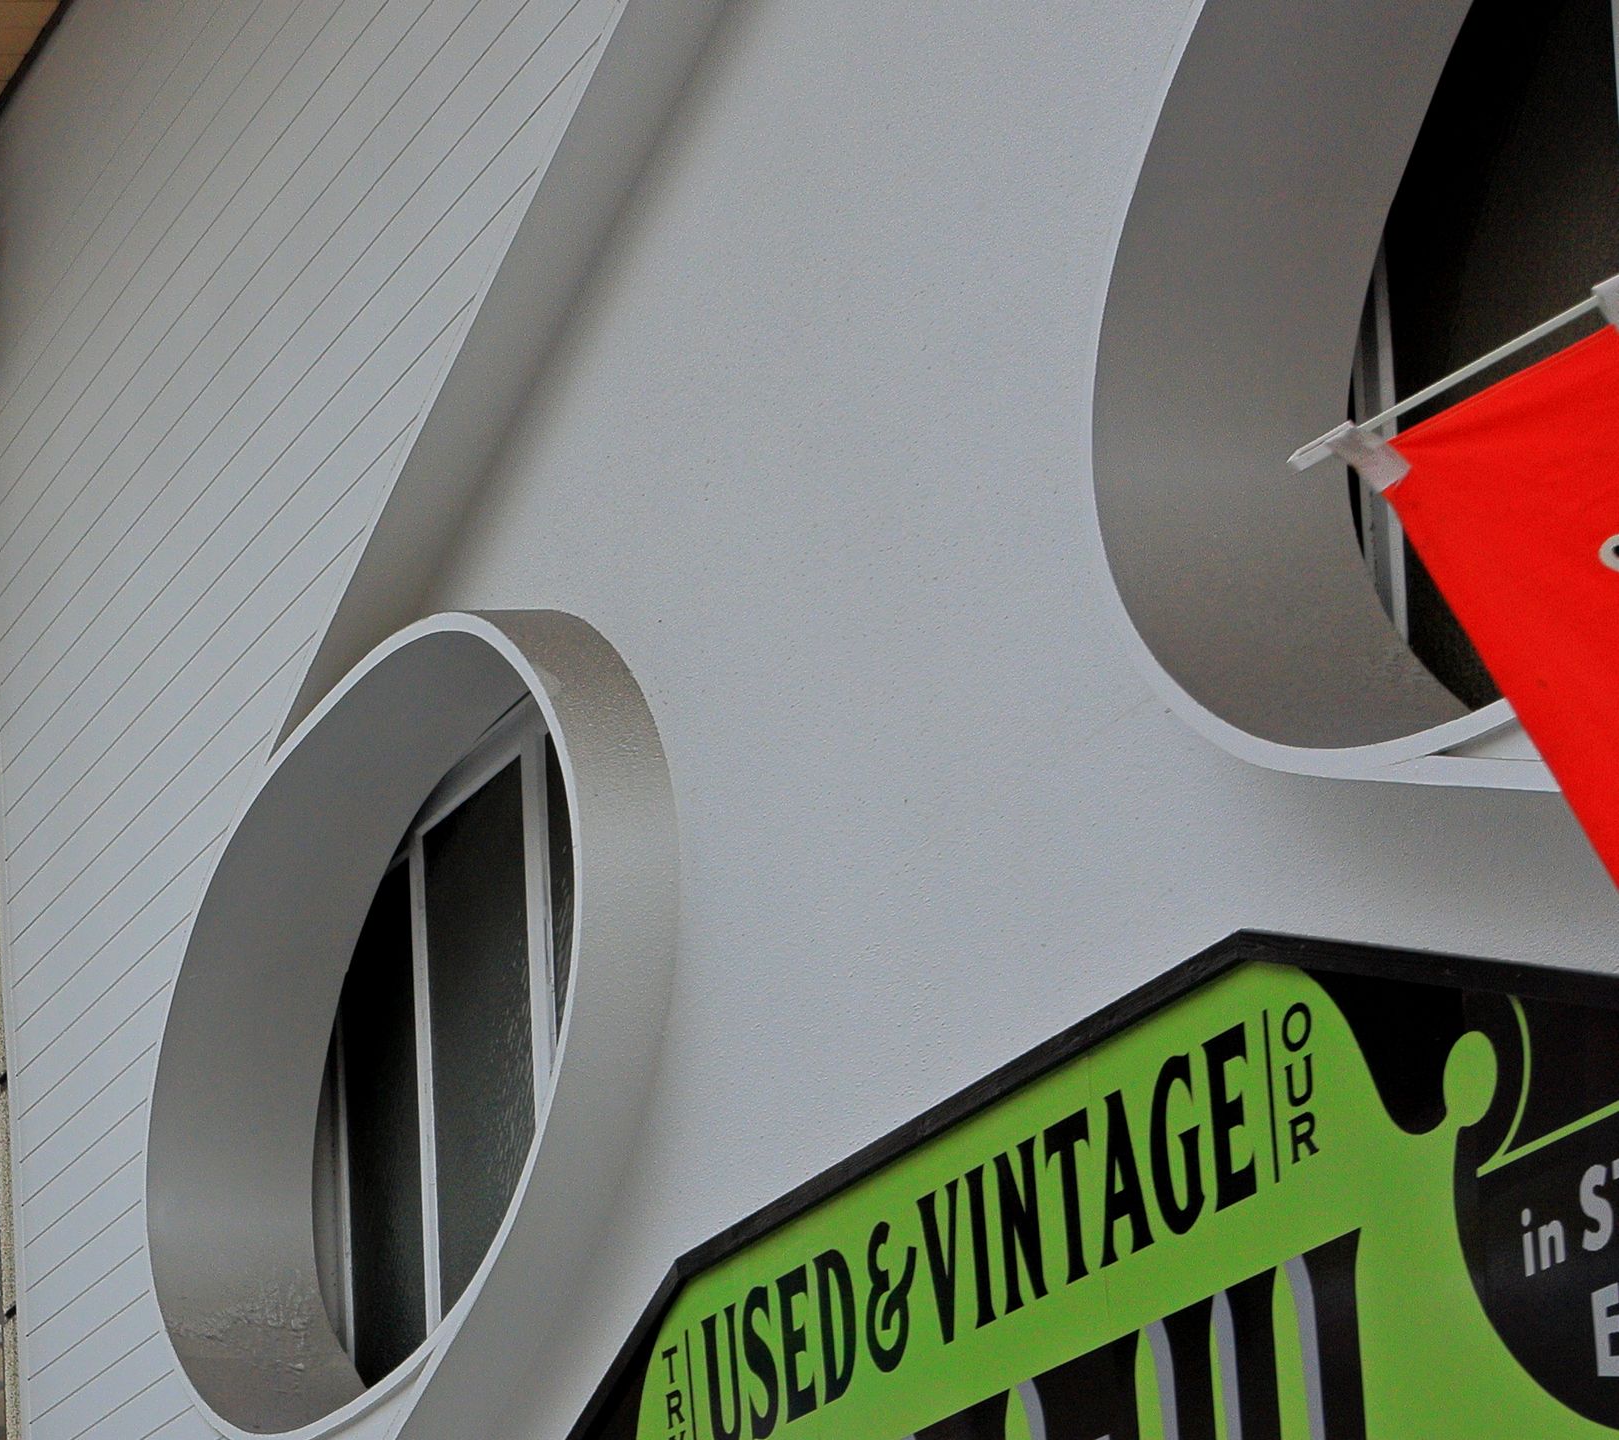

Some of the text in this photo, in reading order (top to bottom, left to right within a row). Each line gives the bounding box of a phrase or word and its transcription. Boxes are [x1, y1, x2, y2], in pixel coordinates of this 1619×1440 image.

[1280, 1000, 1321, 1163] OUR
[918, 1018, 1262, 1345] VINTAGE
[1521, 1154, 1619, 1279] in S
